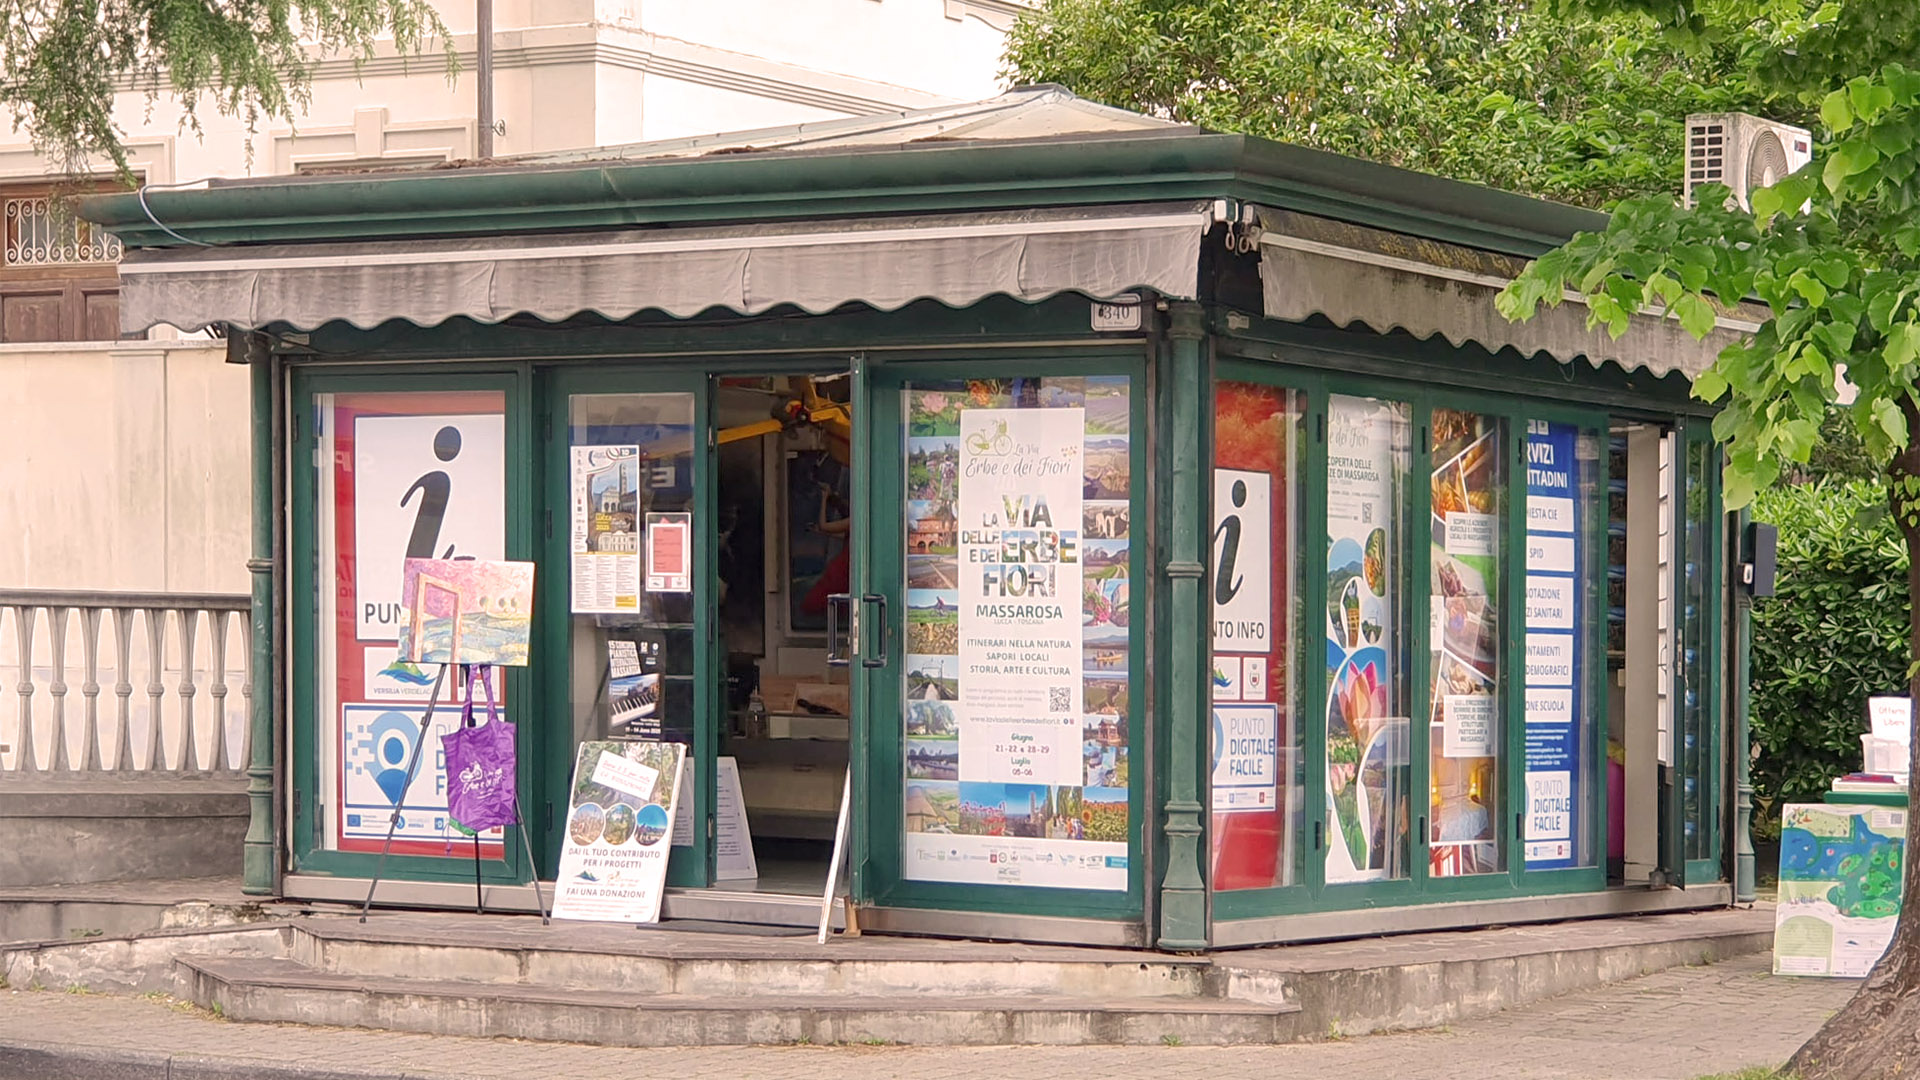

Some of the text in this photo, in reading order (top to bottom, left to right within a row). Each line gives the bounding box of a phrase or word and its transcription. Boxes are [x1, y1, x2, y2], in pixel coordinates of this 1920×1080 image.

[965, 457, 1073, 478] Erbe e dei Fiori
[1354, 459, 1372, 470] DELLE
[1337, 469, 1343, 478] DI
[1344, 469, 1380, 482] MASSAROSA
[983, 494, 1053, 528] LA VIA
[1548, 509, 1558, 520] CIE
[962, 530, 1078, 563] DELLE ERBE
[970, 548, 1000, 563] E DEI
[1529, 548, 1544, 559] SPID
[983, 565, 1056, 597] FIORI
[976, 604, 1063, 619] MASSAROSA
[1534, 606, 1562, 619] SANITARI
[1237, 621, 1264, 639] INFO
[967, 638, 1071, 649] ITINERARI NELLA NATURA
[986, 652, 1050, 662] SAPORI LOCALI
[970, 665, 1000, 675] STORIA,
[1003, 666, 1023, 675] ARTE
[1032, 667, 1071, 676] CULTURA
[1526, 664, 1569, 676] DEMOGRAFICI
[1540, 701, 1565, 711] SCUOLA
[1230, 718, 1265, 735] PUNTO
[995, 744, 1018, 753] 21-22
[1230, 738, 1275, 755] DIGITALE
[1230, 759, 1263, 776] FACILE
[1534, 779, 1563, 796] PUNTO
[1534, 798, 1571, 813] DIGITALE
[1534, 815, 1560, 832] FACILE
[568, 848, 581, 856] DAI
[592, 848, 608, 857] TUO
[610, 849, 661, 859] CONTRIBUTO
[583, 859, 597, 867] PER
[604, 860, 642, 869] PROGETTI
[566, 887, 578, 896] FAI
[580, 888, 598, 896] UNA
